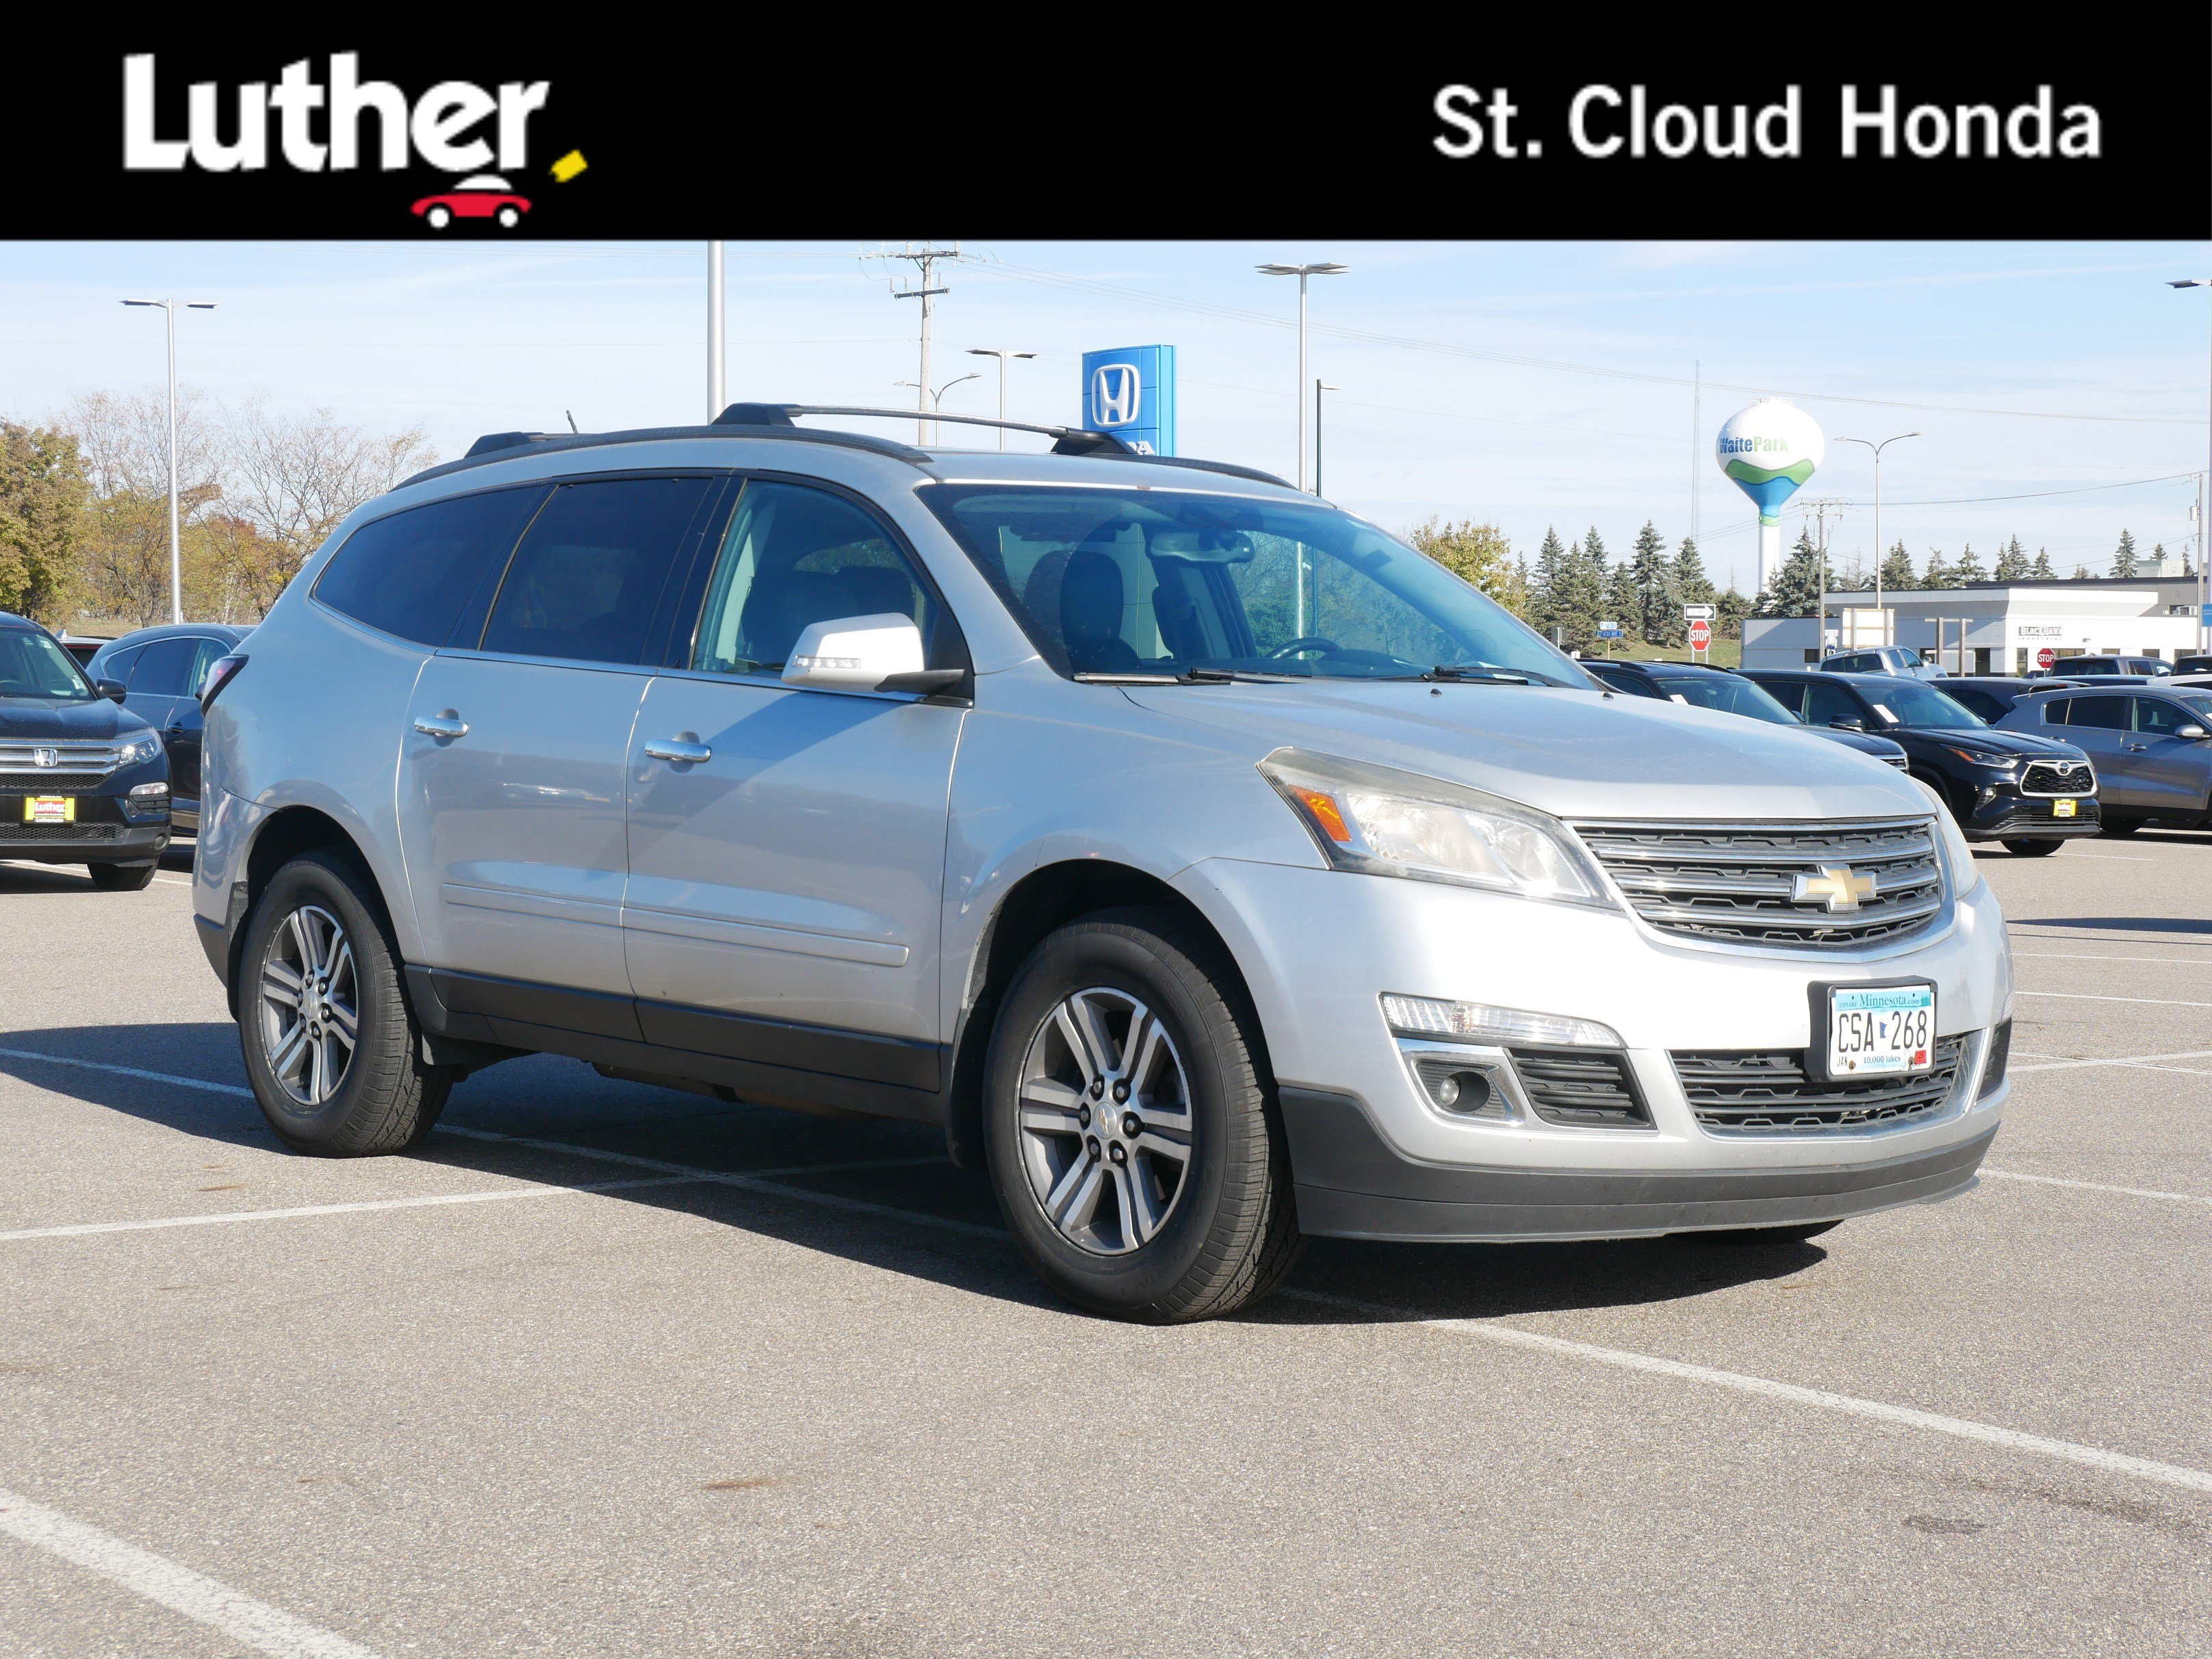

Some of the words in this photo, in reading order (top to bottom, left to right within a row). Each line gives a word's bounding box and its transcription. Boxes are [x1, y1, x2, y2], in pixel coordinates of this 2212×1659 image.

[1690, 629, 1709, 642] STOP
[2038, 654, 2054, 663] STOP
[1838, 1012, 1874, 1053] CSA
[1891, 1010, 1927, 1050] 268
[1837, 1055, 1848, 1067] JAN
